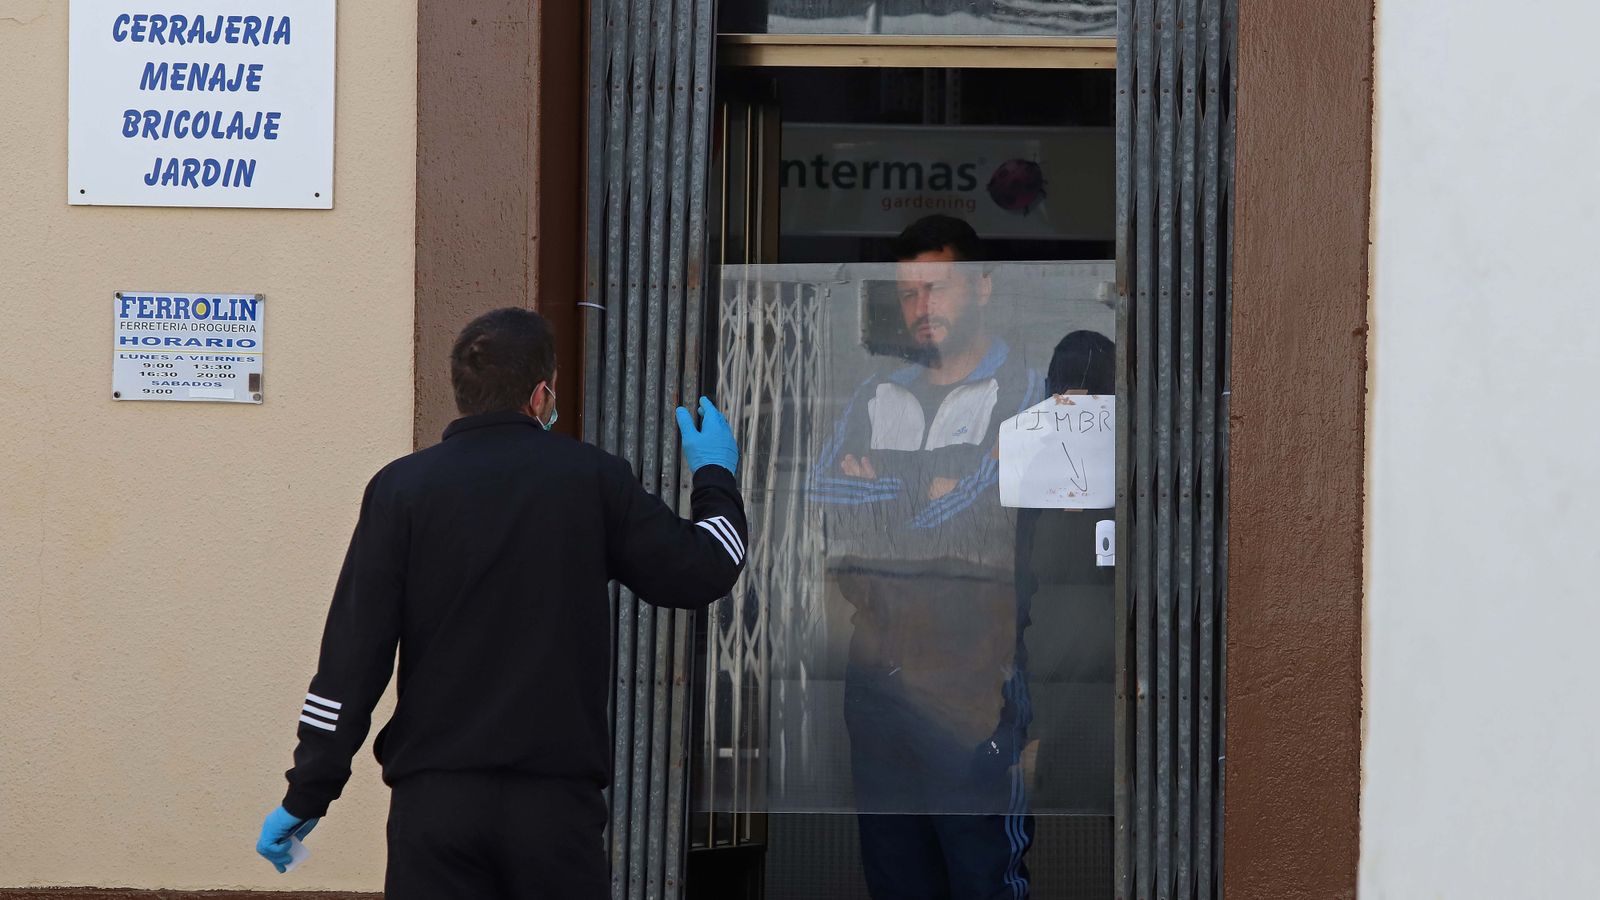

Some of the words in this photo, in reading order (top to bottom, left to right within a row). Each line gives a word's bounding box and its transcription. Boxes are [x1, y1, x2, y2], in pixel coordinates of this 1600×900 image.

[112, 13, 291, 47] CERRAJERIA
[139, 62, 263, 92] MENAJE
[122, 109, 281, 141] BRICOLAJE
[144, 157, 256, 189] JARDIN
[780, 154, 977, 192] ntermas
[881, 195, 976, 213] gardening
[119, 296, 258, 321] FERROLIN
[119, 336, 257, 348] HORARIO
[120, 321, 188, 332] FERRETERIA
[191, 322, 257, 333] DROGUERIA
